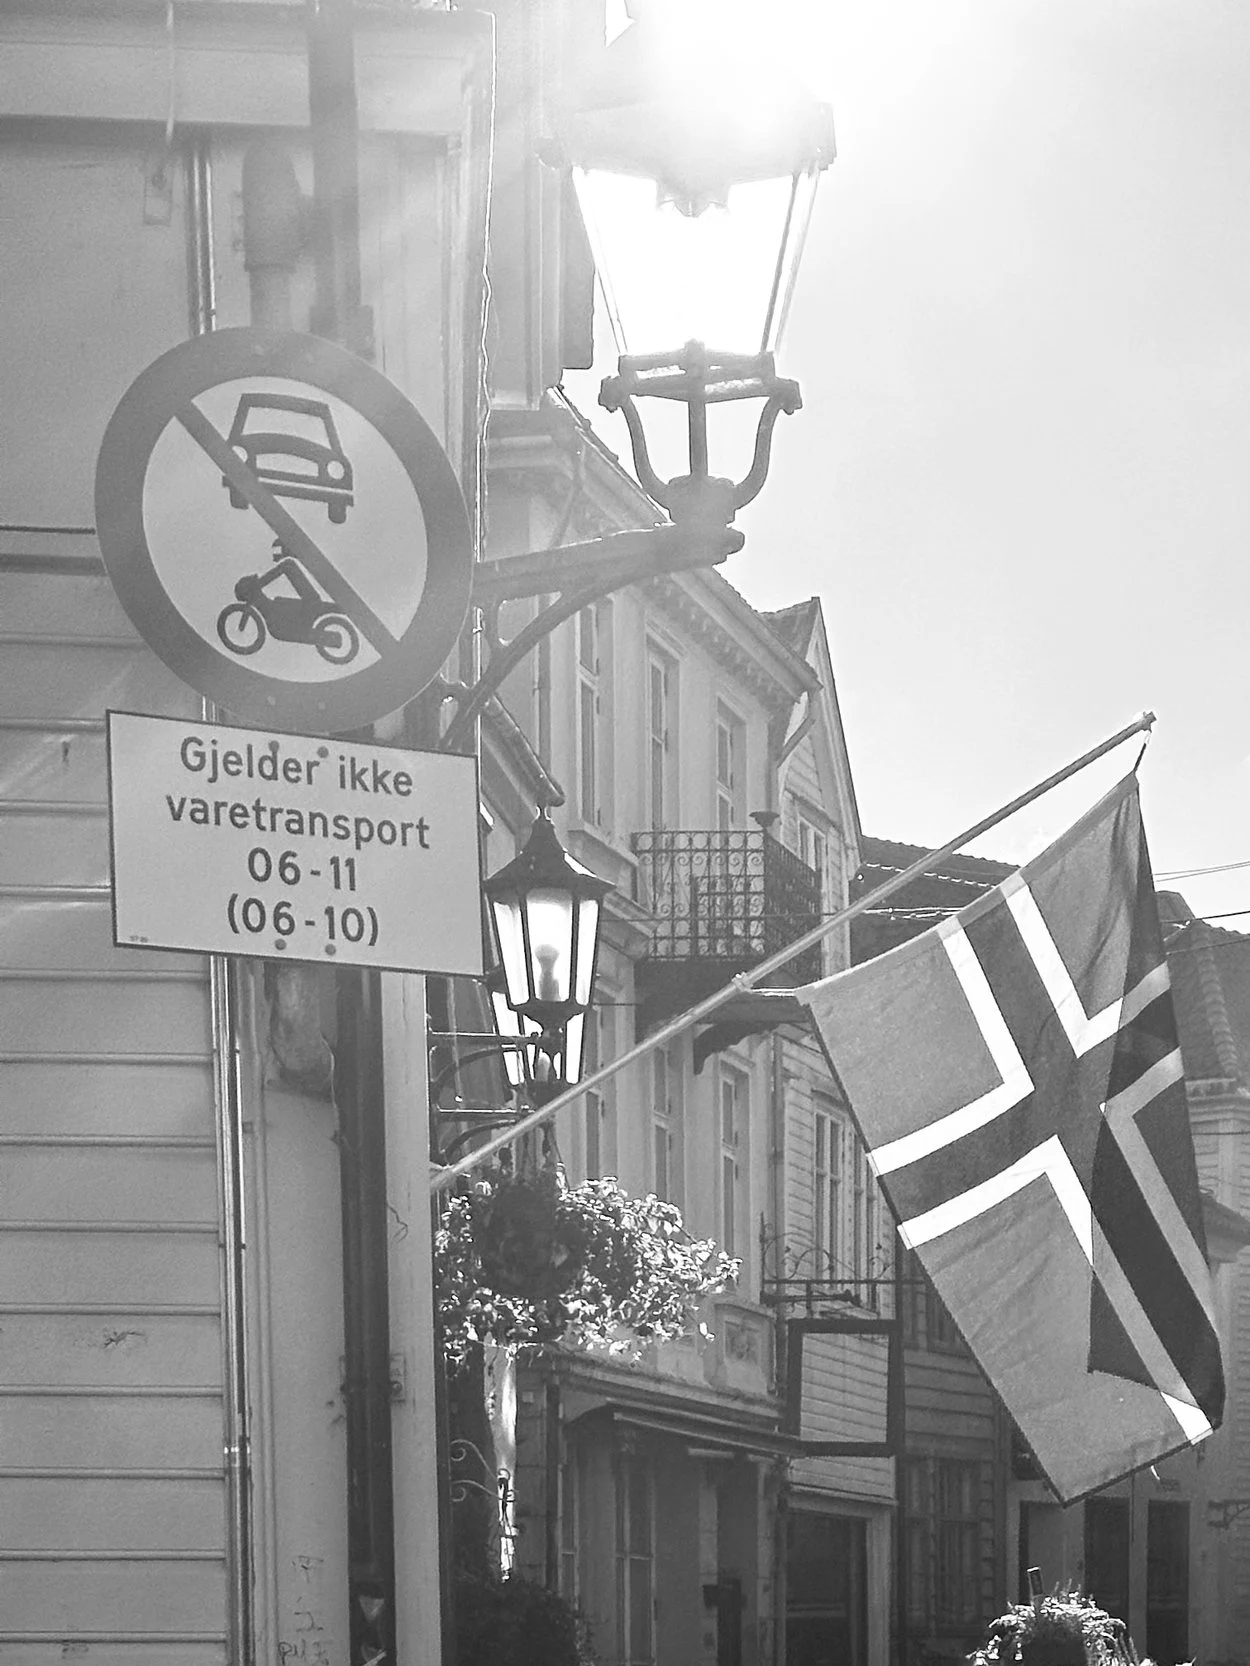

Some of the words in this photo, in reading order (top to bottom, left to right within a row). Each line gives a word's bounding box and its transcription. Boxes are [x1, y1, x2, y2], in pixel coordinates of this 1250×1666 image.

[180, 736, 320, 784] Gjelder
[338, 754, 414, 797] ikke
[166, 794, 431, 850] varetransport
[248, 847, 357, 891] 06-11
[227, 893, 379, 946] (06-10)
